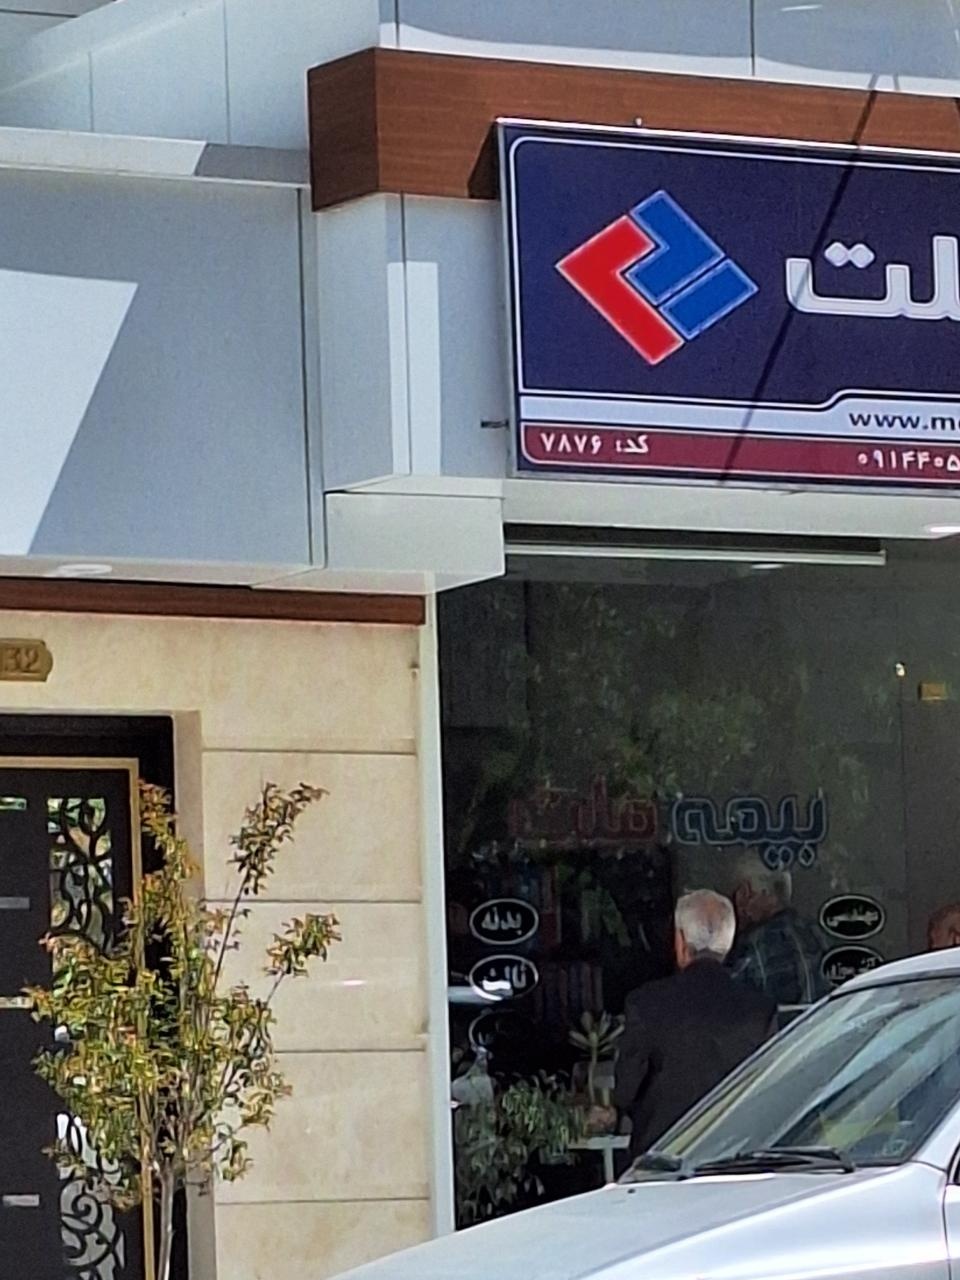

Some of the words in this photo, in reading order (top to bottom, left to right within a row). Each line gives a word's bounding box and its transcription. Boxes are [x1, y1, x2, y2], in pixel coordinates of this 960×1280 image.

[540, 432, 602, 455] ۷۸۷۶
[615, 434, 649, 454] کد:
[672, 788, 826, 868] بیمه
